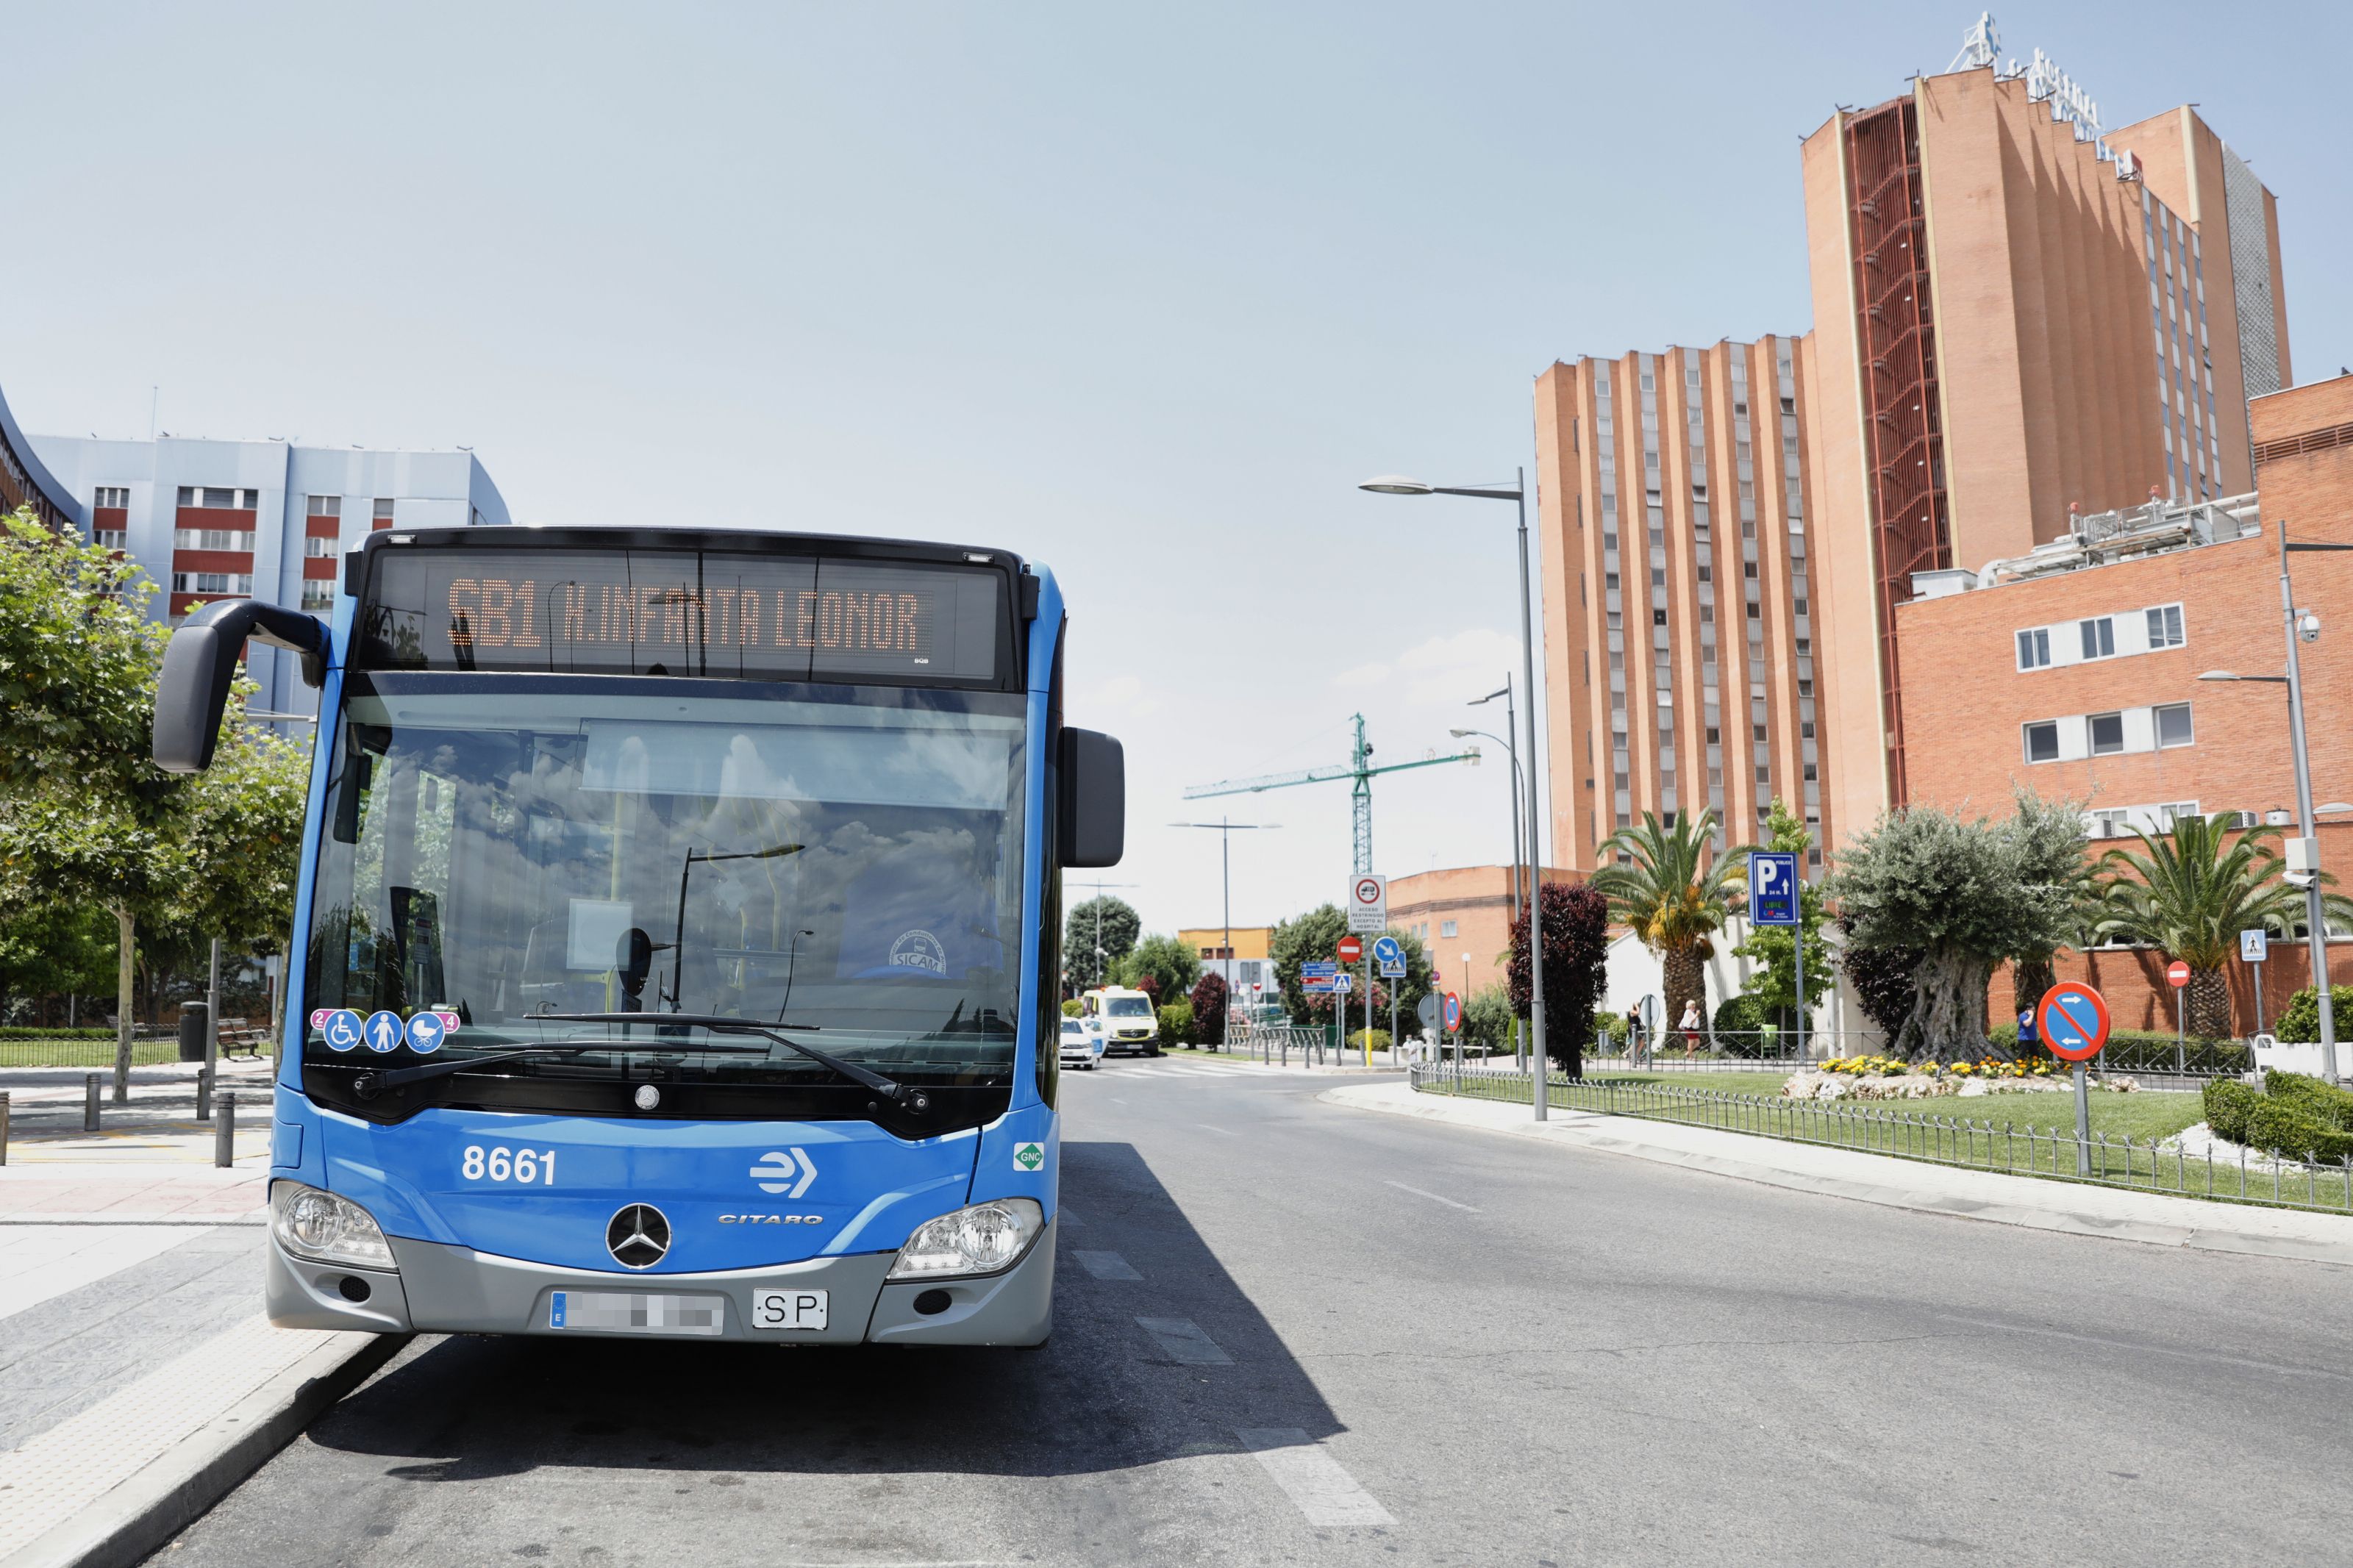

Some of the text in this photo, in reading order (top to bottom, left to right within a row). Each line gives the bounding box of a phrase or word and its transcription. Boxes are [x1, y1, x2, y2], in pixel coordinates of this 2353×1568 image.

[447, 579, 918, 650] SB1 H.INFANTA LEONOR
[1757, 859, 1777, 895] P
[905, 931, 938, 947] Conductores
[897, 955, 938, 971] SICAM
[315, 1012, 324, 1024] 2
[446, 1015, 454, 1027] 4
[1021, 1152, 1040, 1161] GNC
[462, 1145, 555, 1186] 8661
[718, 1214, 824, 1225] CITARO
[554, 1313, 562, 1322] E
